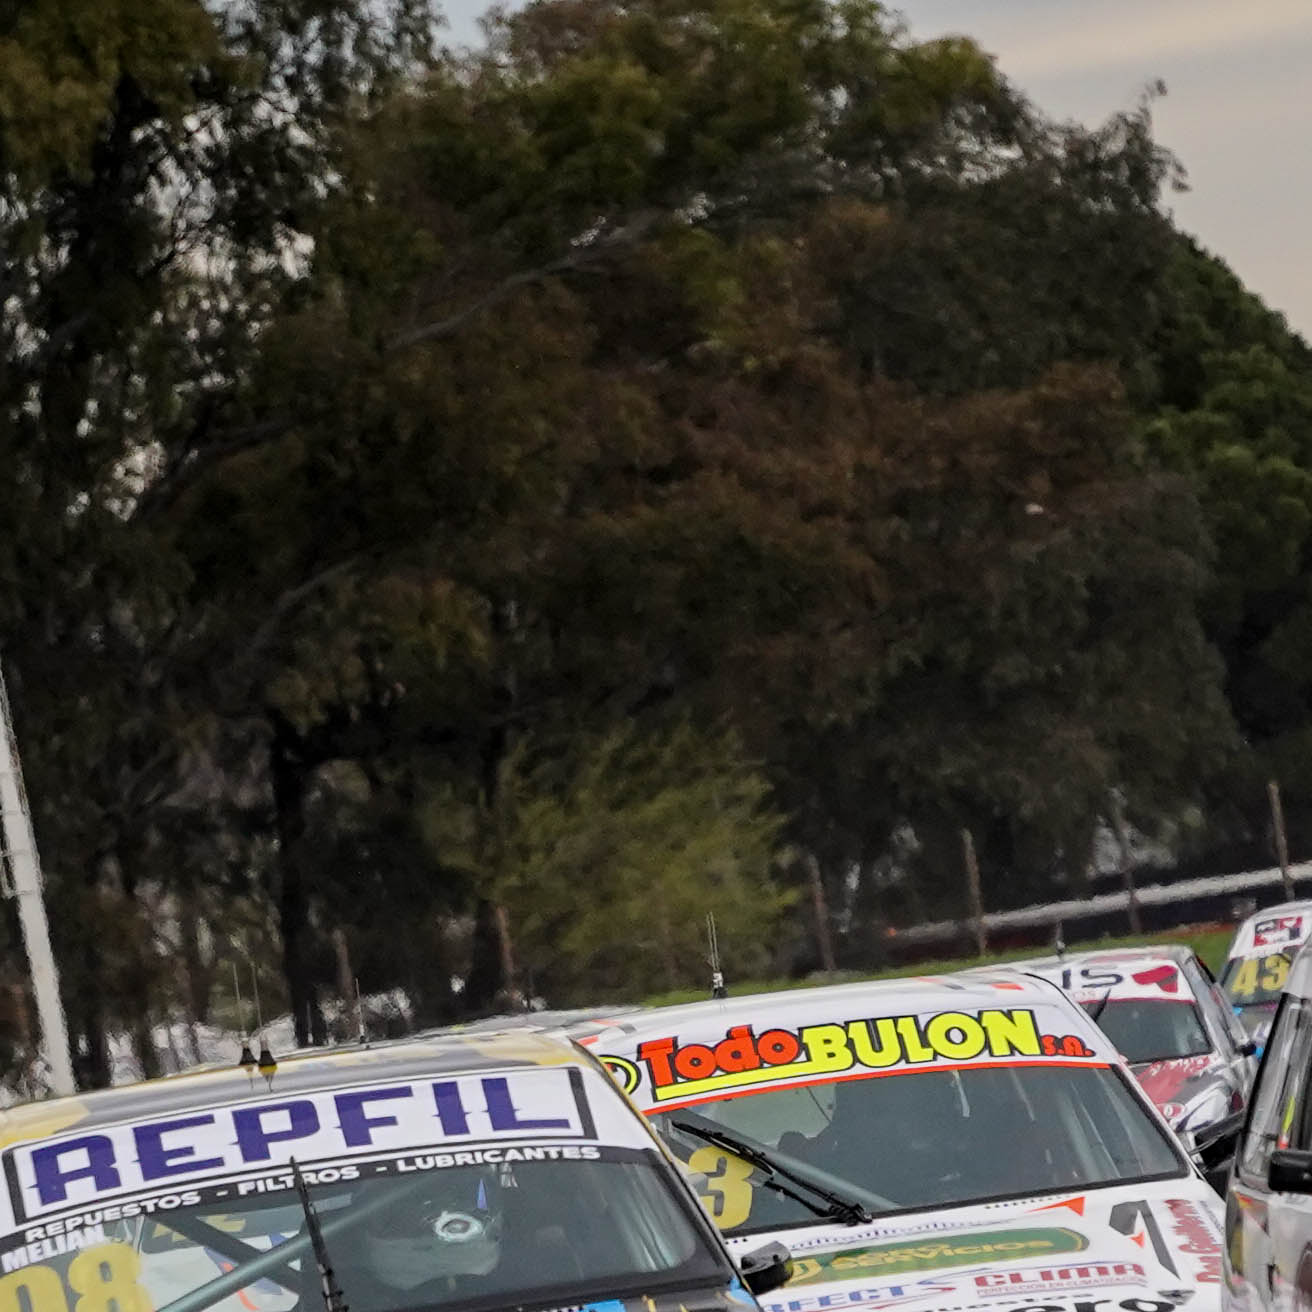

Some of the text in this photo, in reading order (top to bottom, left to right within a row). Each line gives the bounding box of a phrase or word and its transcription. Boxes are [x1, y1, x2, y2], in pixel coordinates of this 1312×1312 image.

[25, 1145, 601, 1242] REPUESTOS FILTROS LUBRICANTES
[29, 1077, 572, 1206] REPFIL
